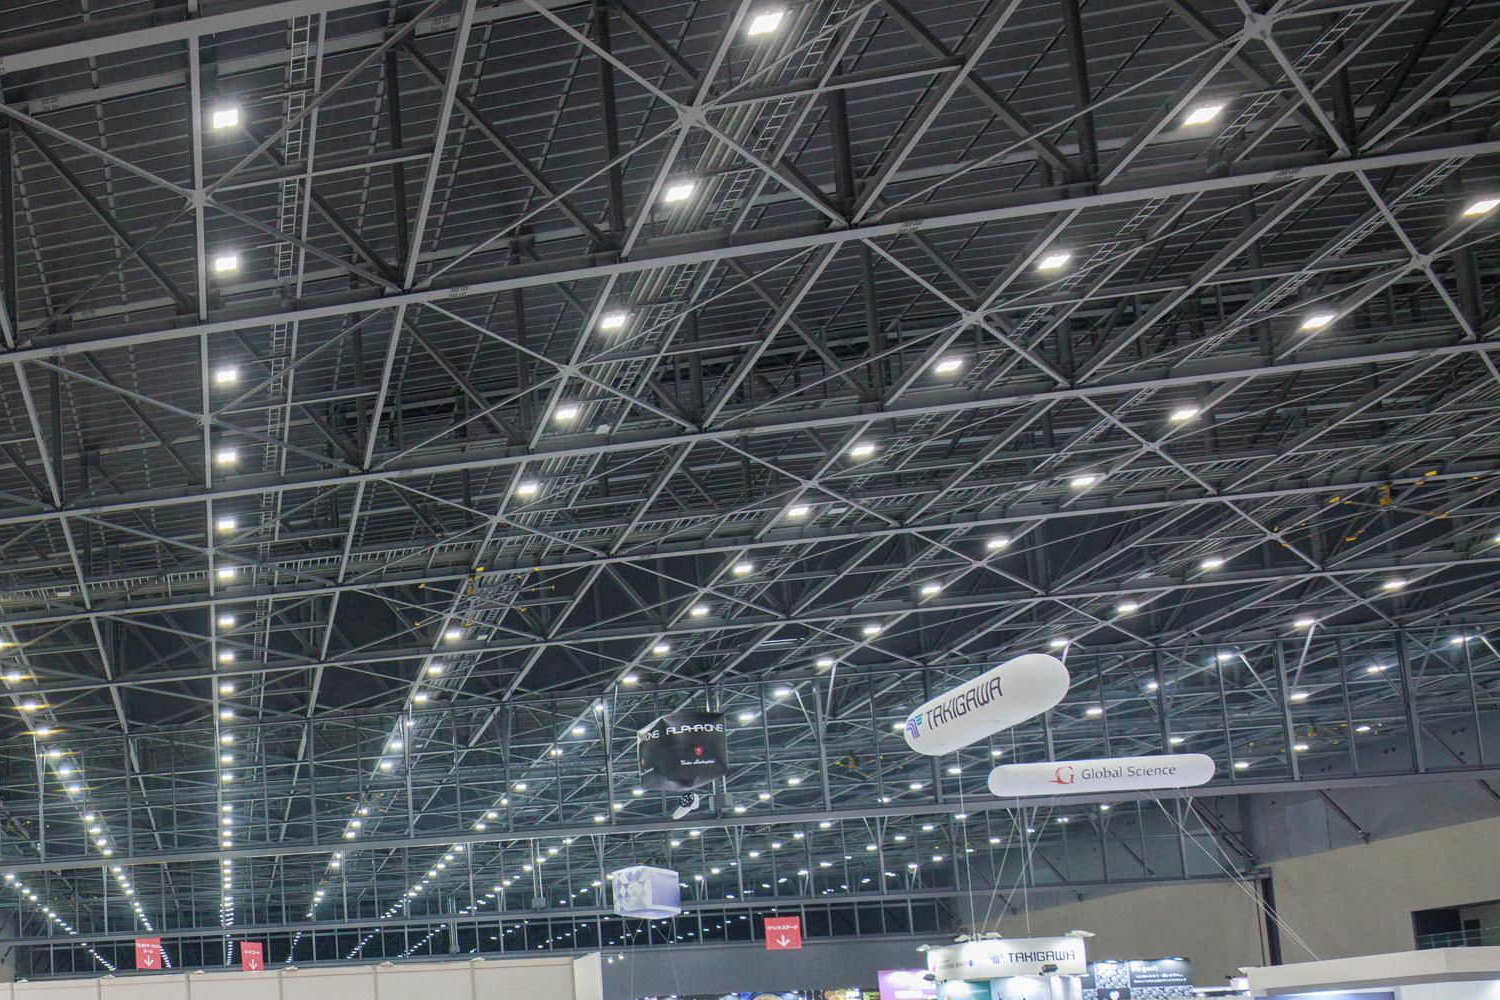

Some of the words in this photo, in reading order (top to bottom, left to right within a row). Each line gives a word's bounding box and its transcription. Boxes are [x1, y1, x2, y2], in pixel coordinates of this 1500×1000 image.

[926, 676, 1003, 730] TAKIGAWA
[1081, 766, 1123, 780] Global
[1127, 766, 1176, 777] Science
[1008, 950, 1076, 963] TAKIGAWA
